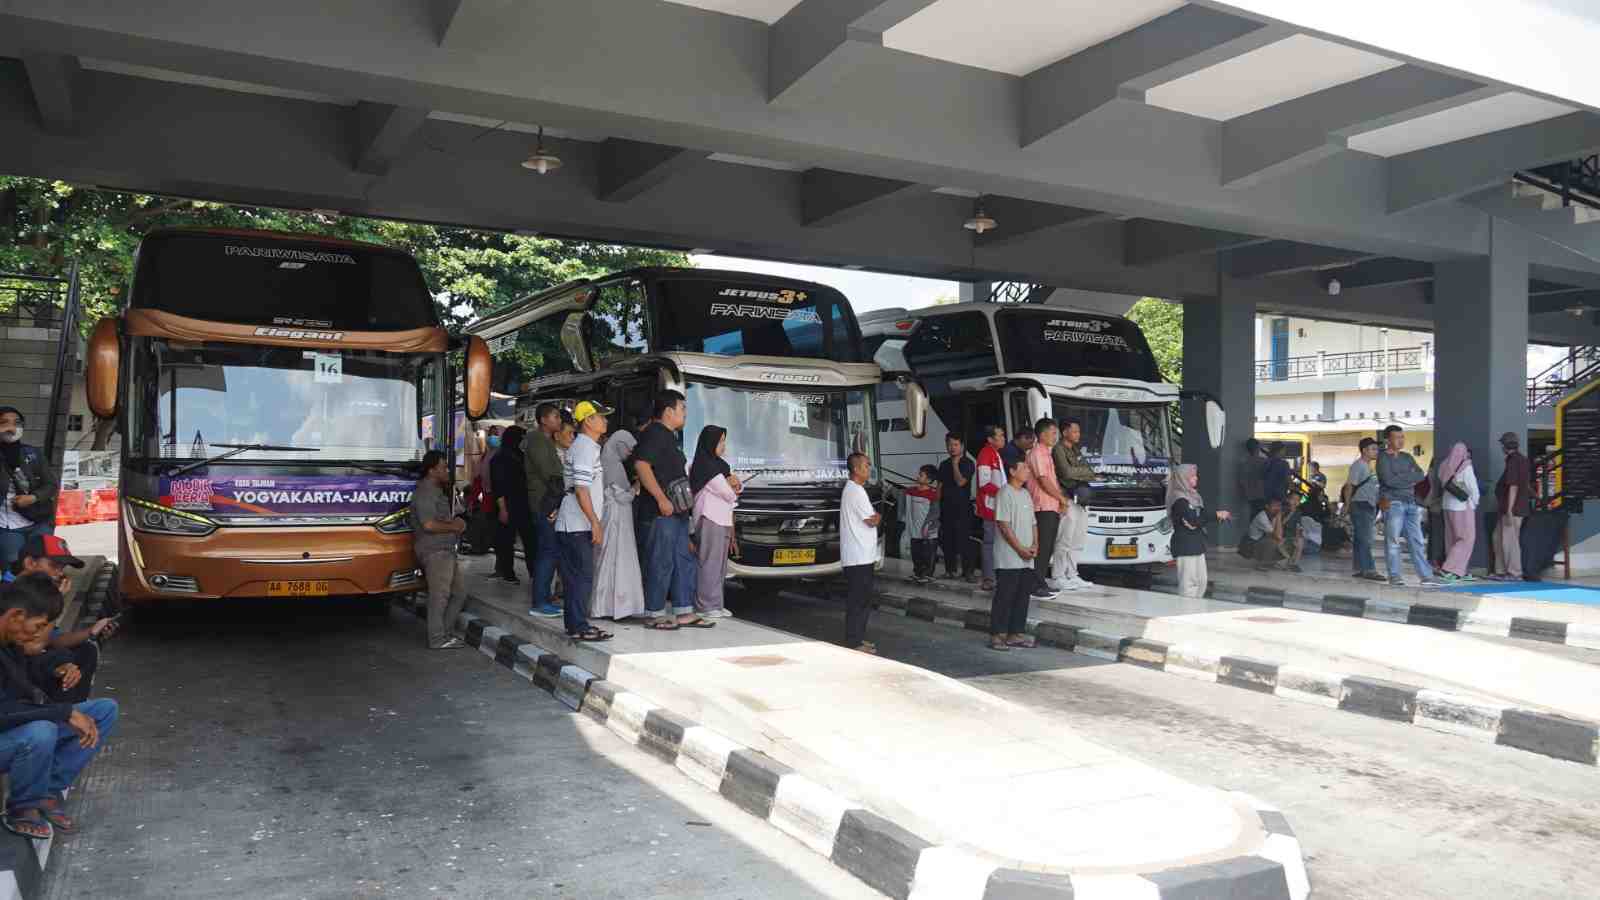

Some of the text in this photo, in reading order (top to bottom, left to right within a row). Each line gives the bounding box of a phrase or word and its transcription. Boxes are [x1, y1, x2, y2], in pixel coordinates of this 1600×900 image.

[224, 245, 357, 265] PARIWISATA
[711, 302, 823, 325] PARIWISATA
[319, 361, 339, 376] 16
